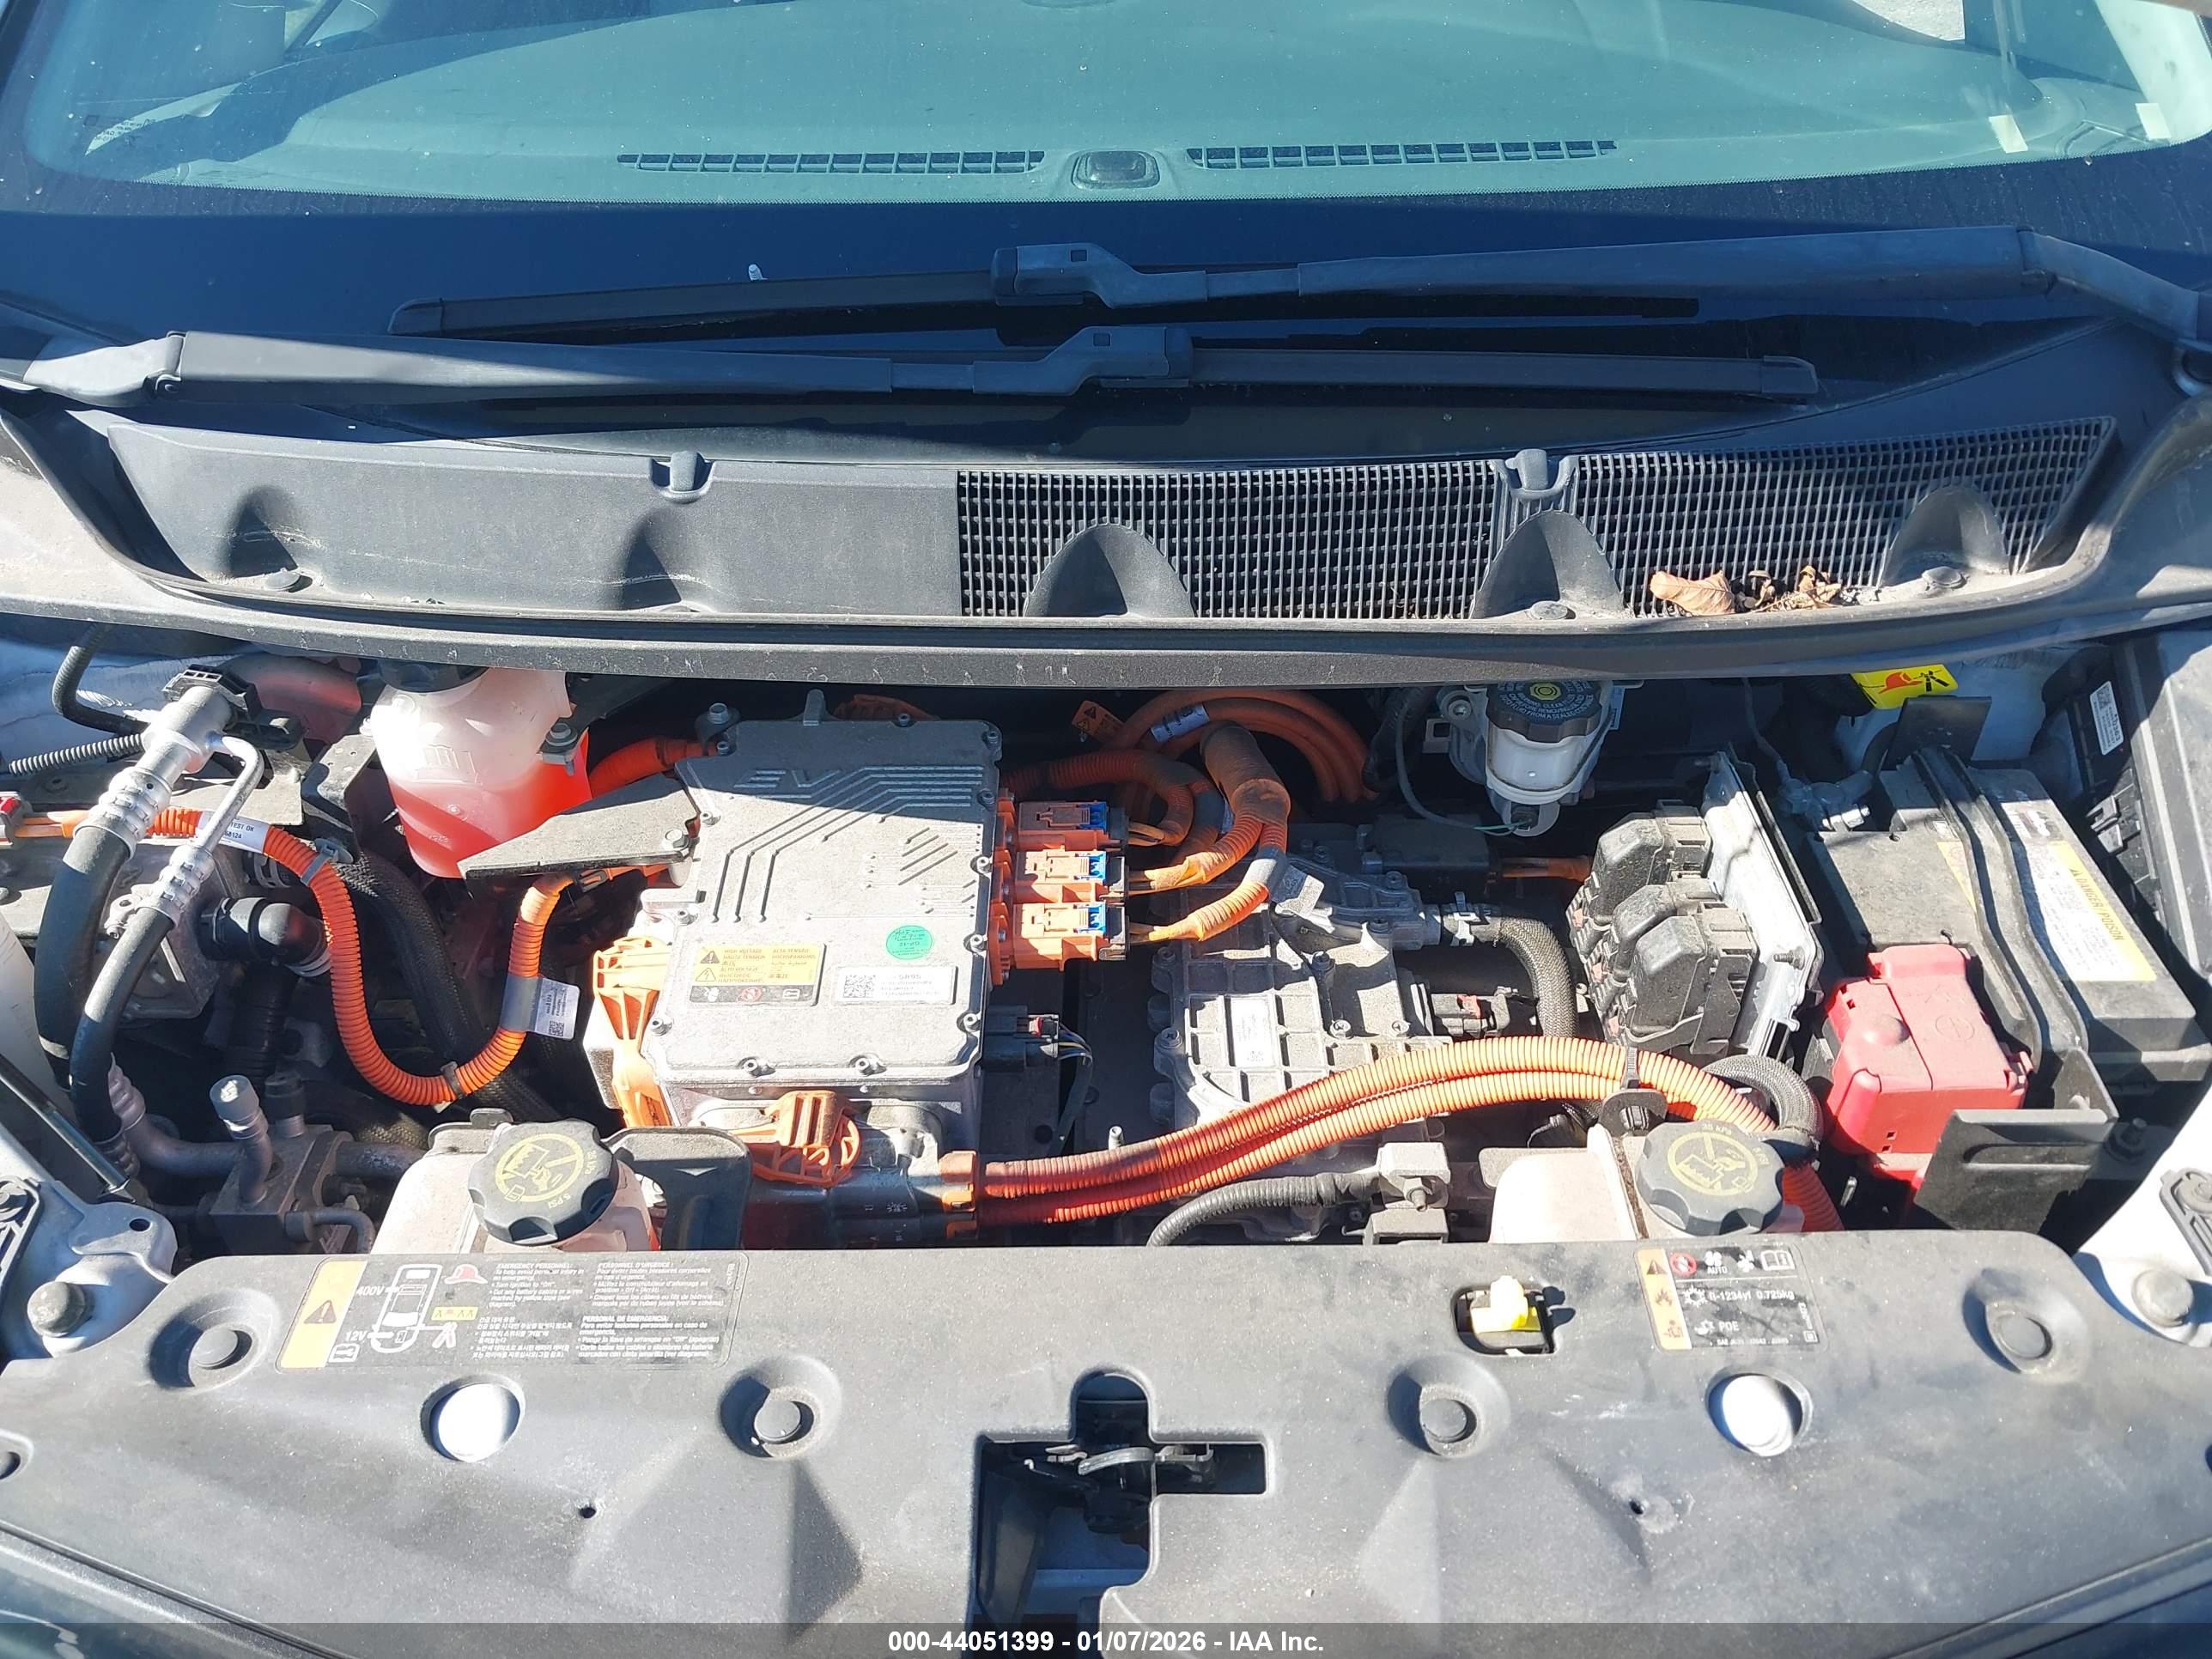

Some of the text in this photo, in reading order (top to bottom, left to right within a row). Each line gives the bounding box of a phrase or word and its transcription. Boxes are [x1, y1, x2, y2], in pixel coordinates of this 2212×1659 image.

[2076, 878, 2104, 908] DANGER
[2100, 910, 2125, 940] POISON
[1707, 1266, 1728, 1274] AUTO
[356, 1285, 385, 1296] 400V
[1718, 1321, 1740, 1332] POE
[345, 1331, 368, 1341] 12V
